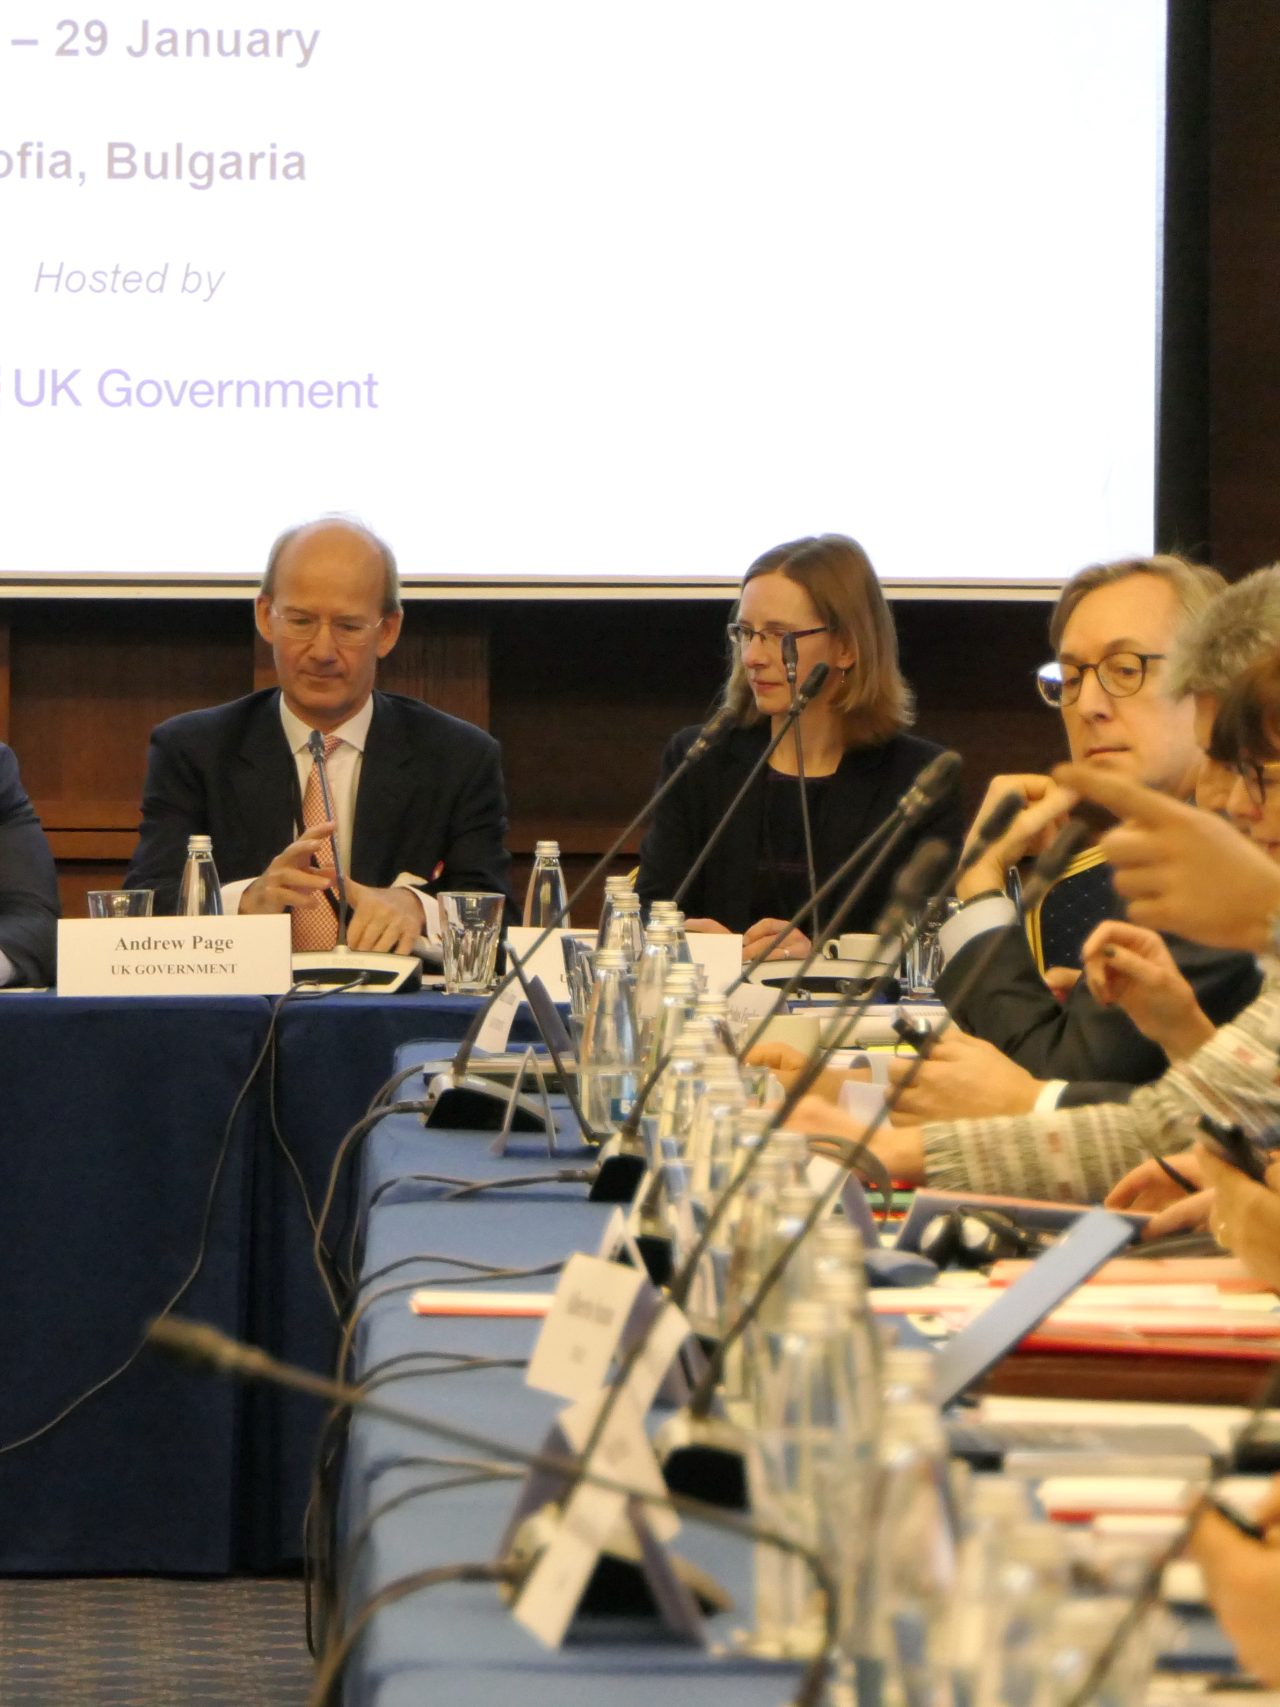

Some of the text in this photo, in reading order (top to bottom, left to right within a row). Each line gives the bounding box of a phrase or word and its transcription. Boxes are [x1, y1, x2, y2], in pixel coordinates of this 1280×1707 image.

[54, 18, 109, 57] 29
[125, 18, 321, 69] January
[106, 141, 307, 191] Bulgaria
[33, 261, 226, 303] Hosted by
[13, 368, 380, 410] UK Government
[114, 935, 235, 954] Andrew Page
[111, 963, 237, 976] UK GOVERNMENT
